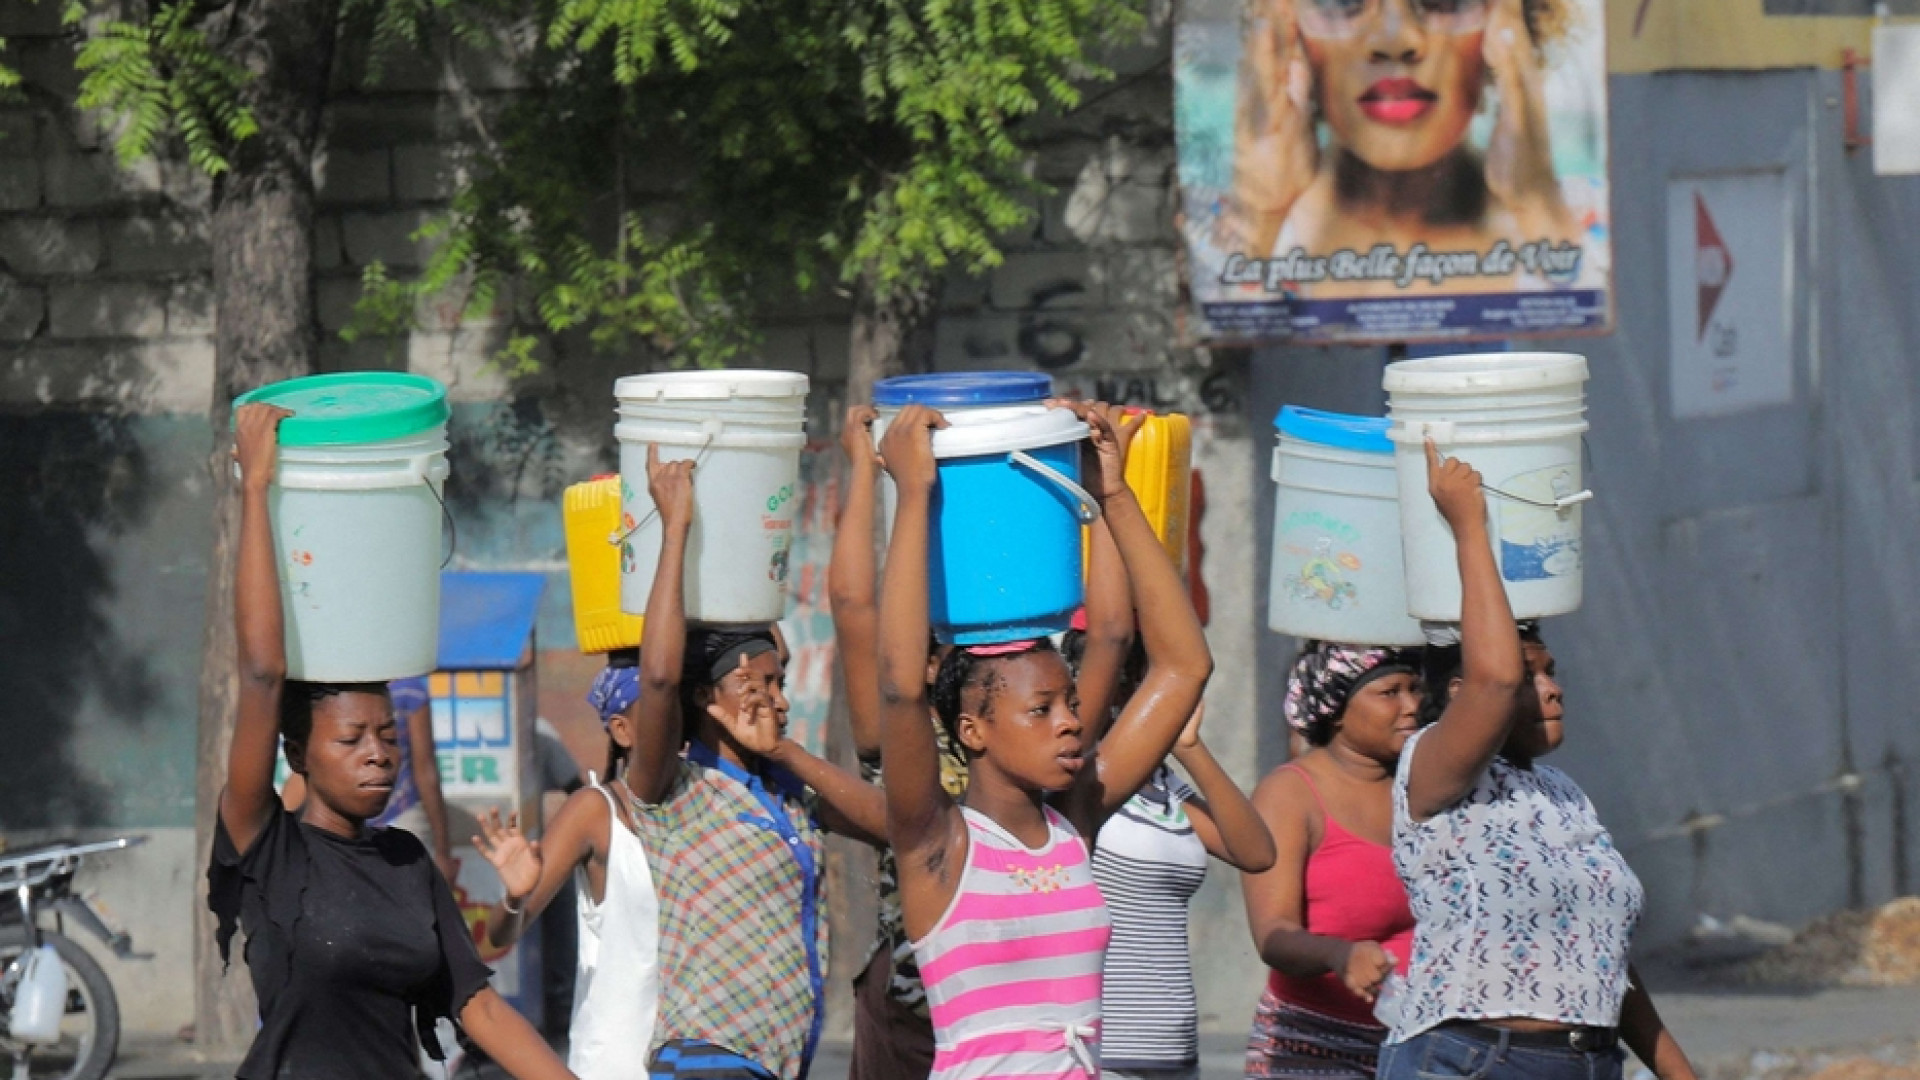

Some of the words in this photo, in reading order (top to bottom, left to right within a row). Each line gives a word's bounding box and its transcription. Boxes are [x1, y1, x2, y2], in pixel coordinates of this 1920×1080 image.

[1221, 252, 1263, 284] La
[1264, 246, 1328, 292] plus
[1329, 243, 1400, 280] Belle
[1395, 242, 1477, 287] façon
[1479, 239, 1516, 276] de
[1518, 237, 1581, 275] Voir
